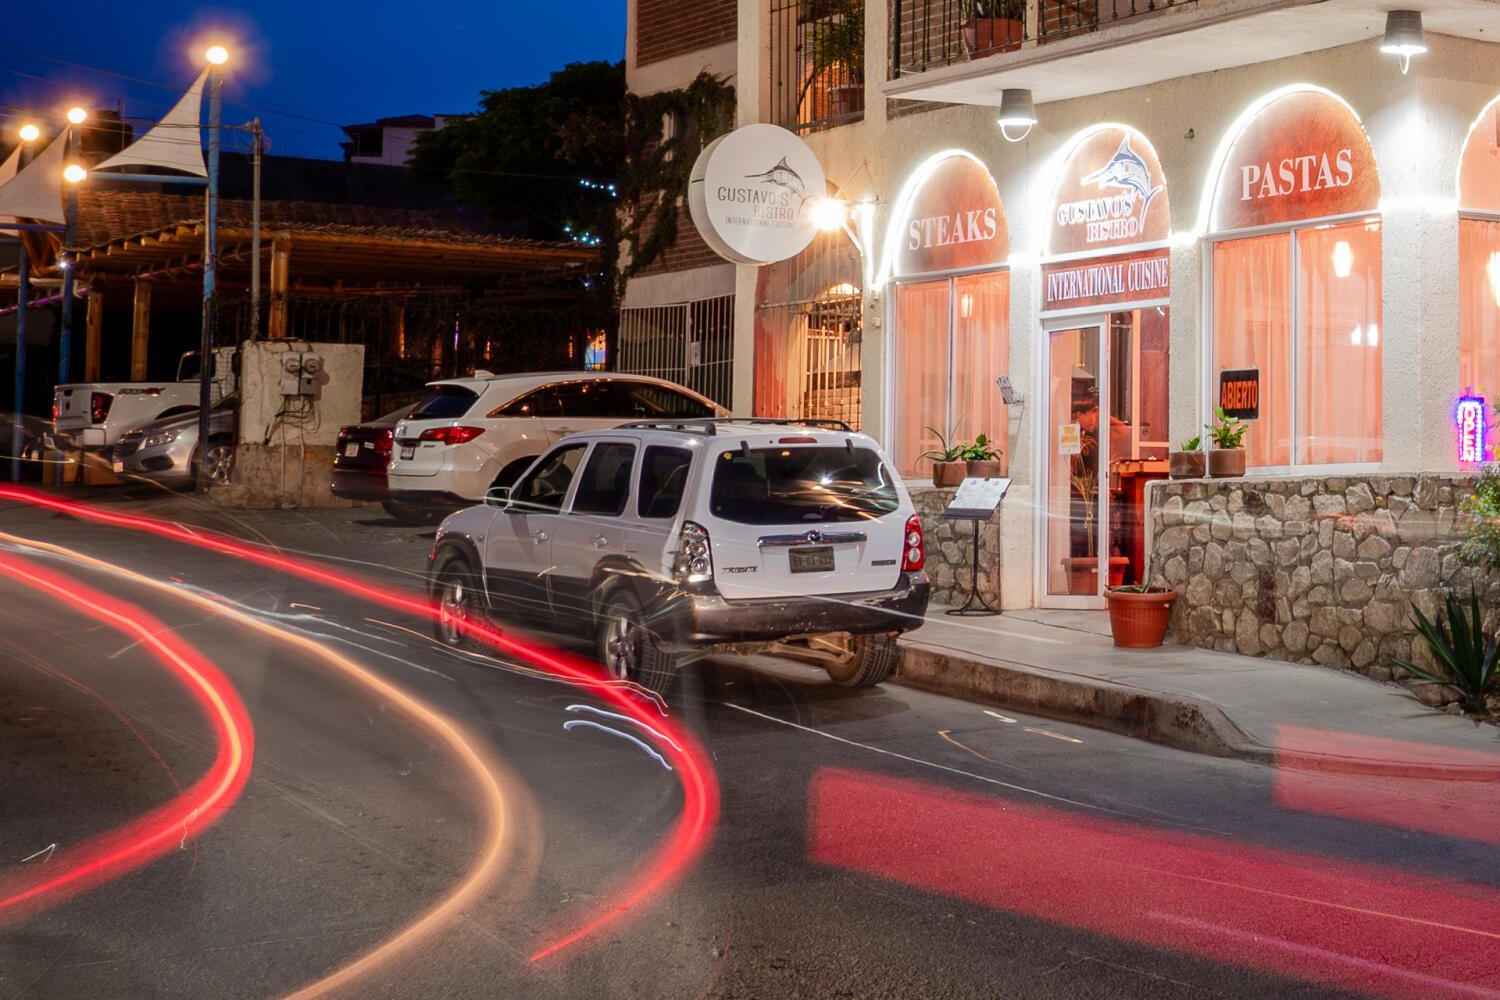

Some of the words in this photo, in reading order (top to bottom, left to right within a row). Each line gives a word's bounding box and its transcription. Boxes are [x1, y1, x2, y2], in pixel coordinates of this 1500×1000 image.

[1240, 149, 1353, 201] PASTAS
[909, 207, 997, 251] STEAKS
[1057, 192, 1133, 225] GUSTAVO'S
[1086, 217, 1138, 242] BISTRO
[1047, 263, 1125, 302] INTERNATIONAL
[1127, 257, 1169, 293] CUISINE
[1220, 380, 1258, 409] ABIERTO
[1462, 404, 1476, 462] OPEN
